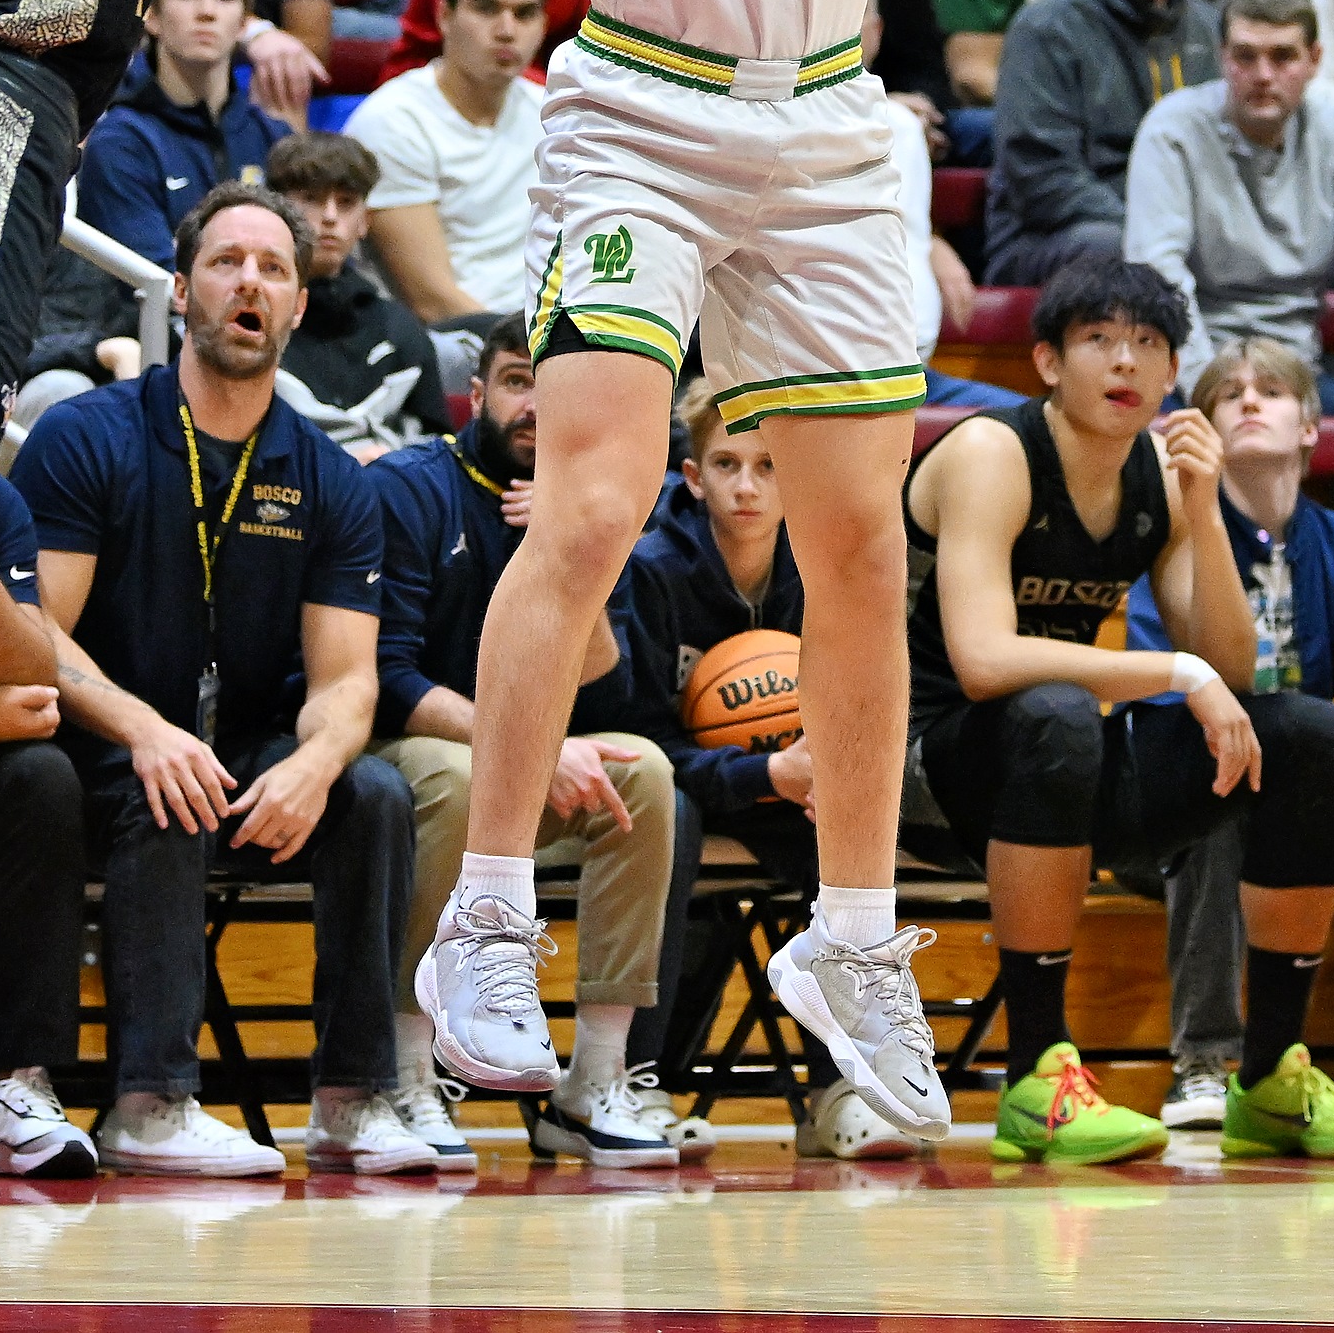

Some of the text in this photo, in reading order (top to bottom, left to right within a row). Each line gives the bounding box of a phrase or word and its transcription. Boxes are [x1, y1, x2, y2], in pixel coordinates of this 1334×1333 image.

[252, 483, 302, 506] BOSCO
[239, 521, 304, 542] BASKETBALL
[716, 669, 799, 712] Wils
